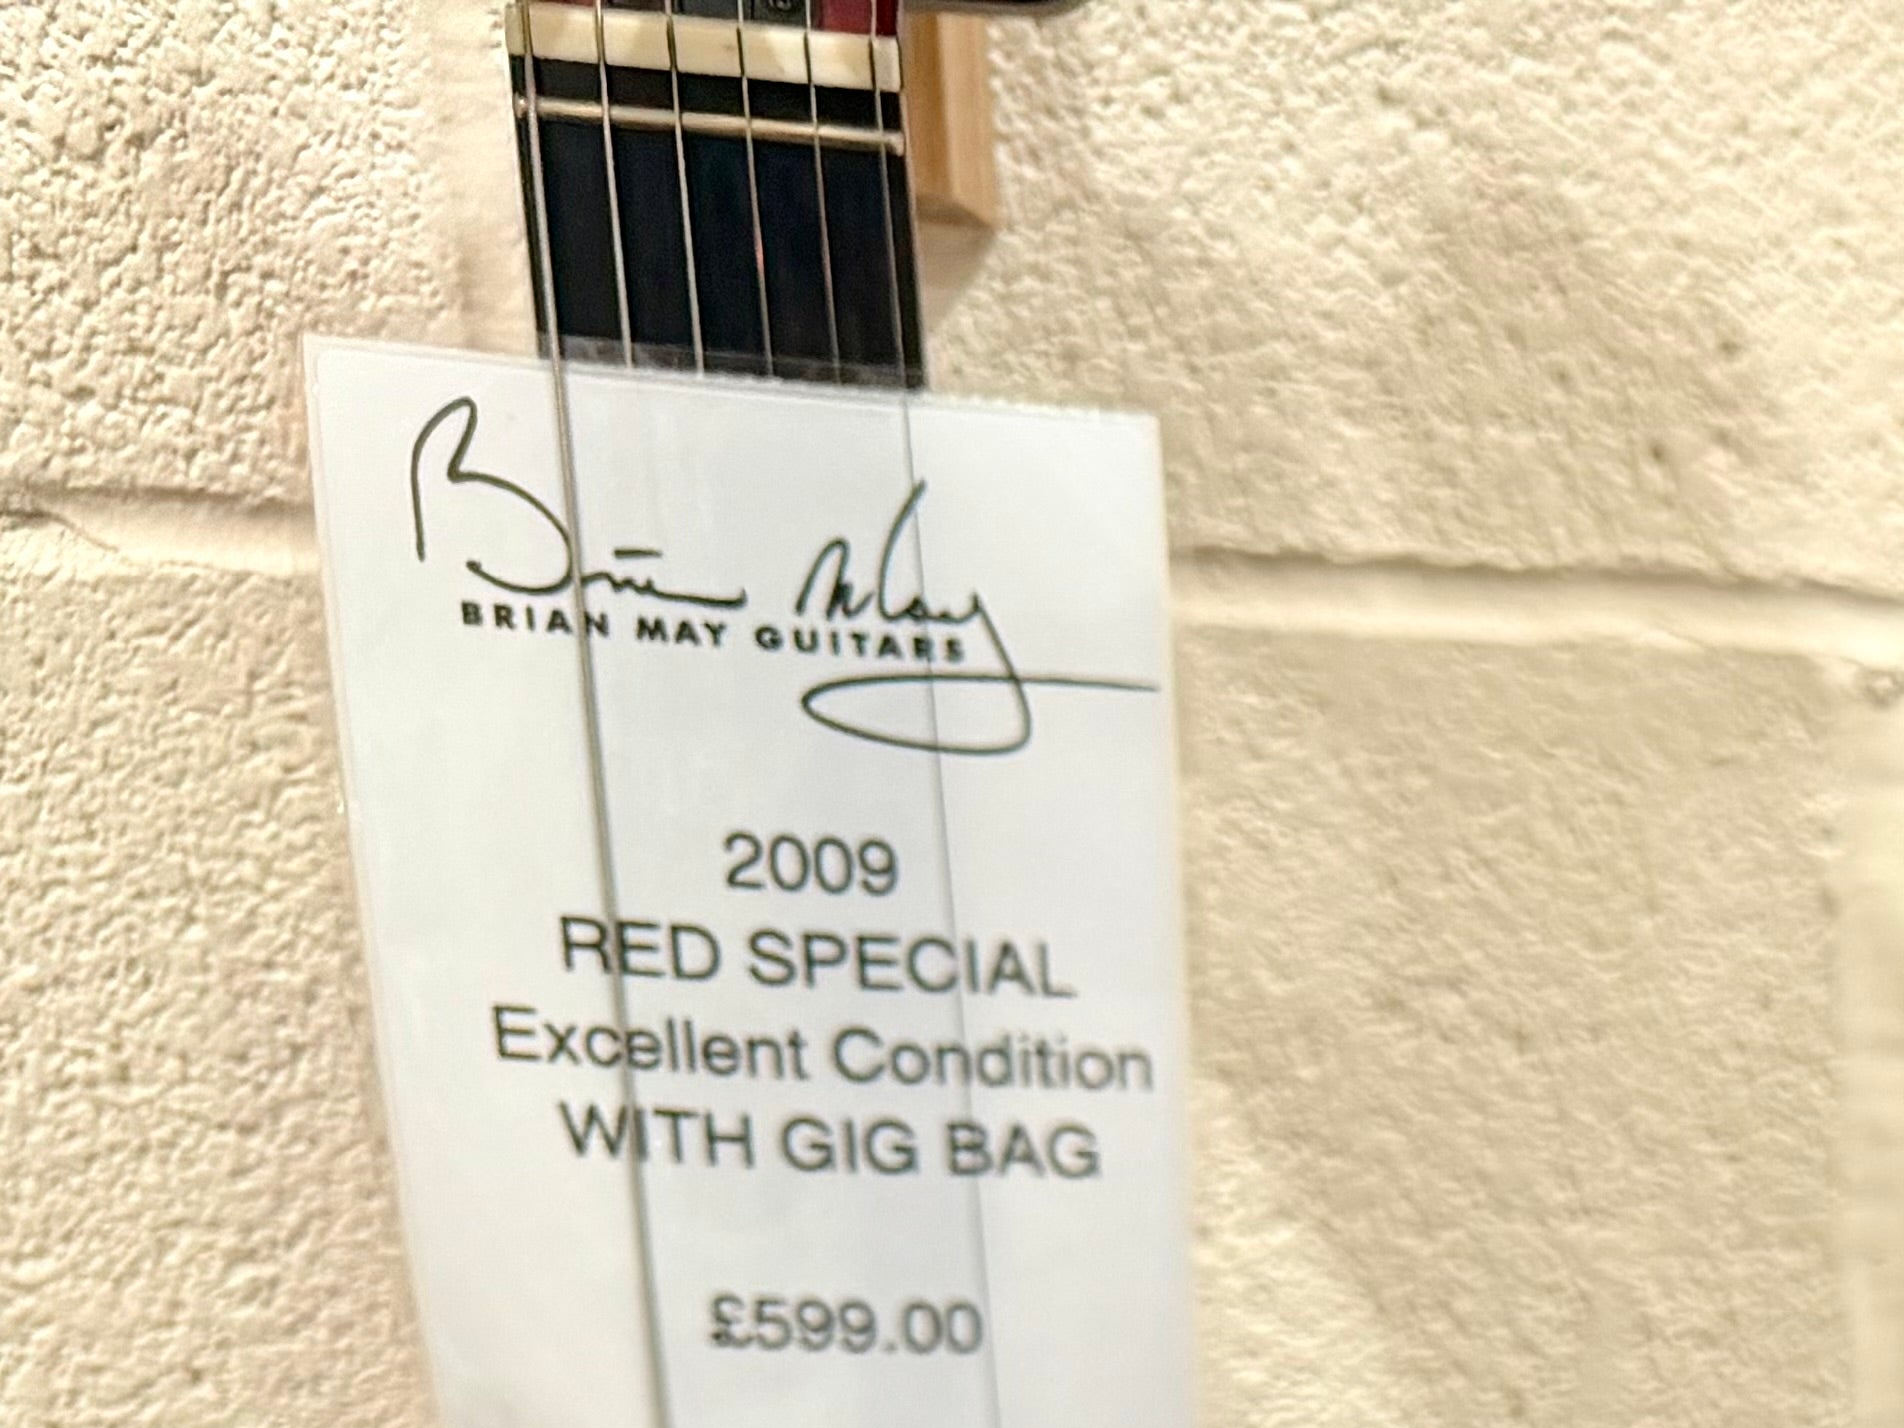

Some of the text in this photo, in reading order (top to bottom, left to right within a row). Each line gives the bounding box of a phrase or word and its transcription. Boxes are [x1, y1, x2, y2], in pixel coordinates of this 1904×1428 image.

[461, 602, 966, 664] BRIAN MAY GUITARS
[725, 833, 898, 896] 2009
[559, 916, 1076, 998] RED SPECIAL
[492, 1005, 1153, 1090] Excellent Condition
[559, 1101, 1100, 1178] WITH GIG BAG
[711, 1295, 983, 1355] £599.00
